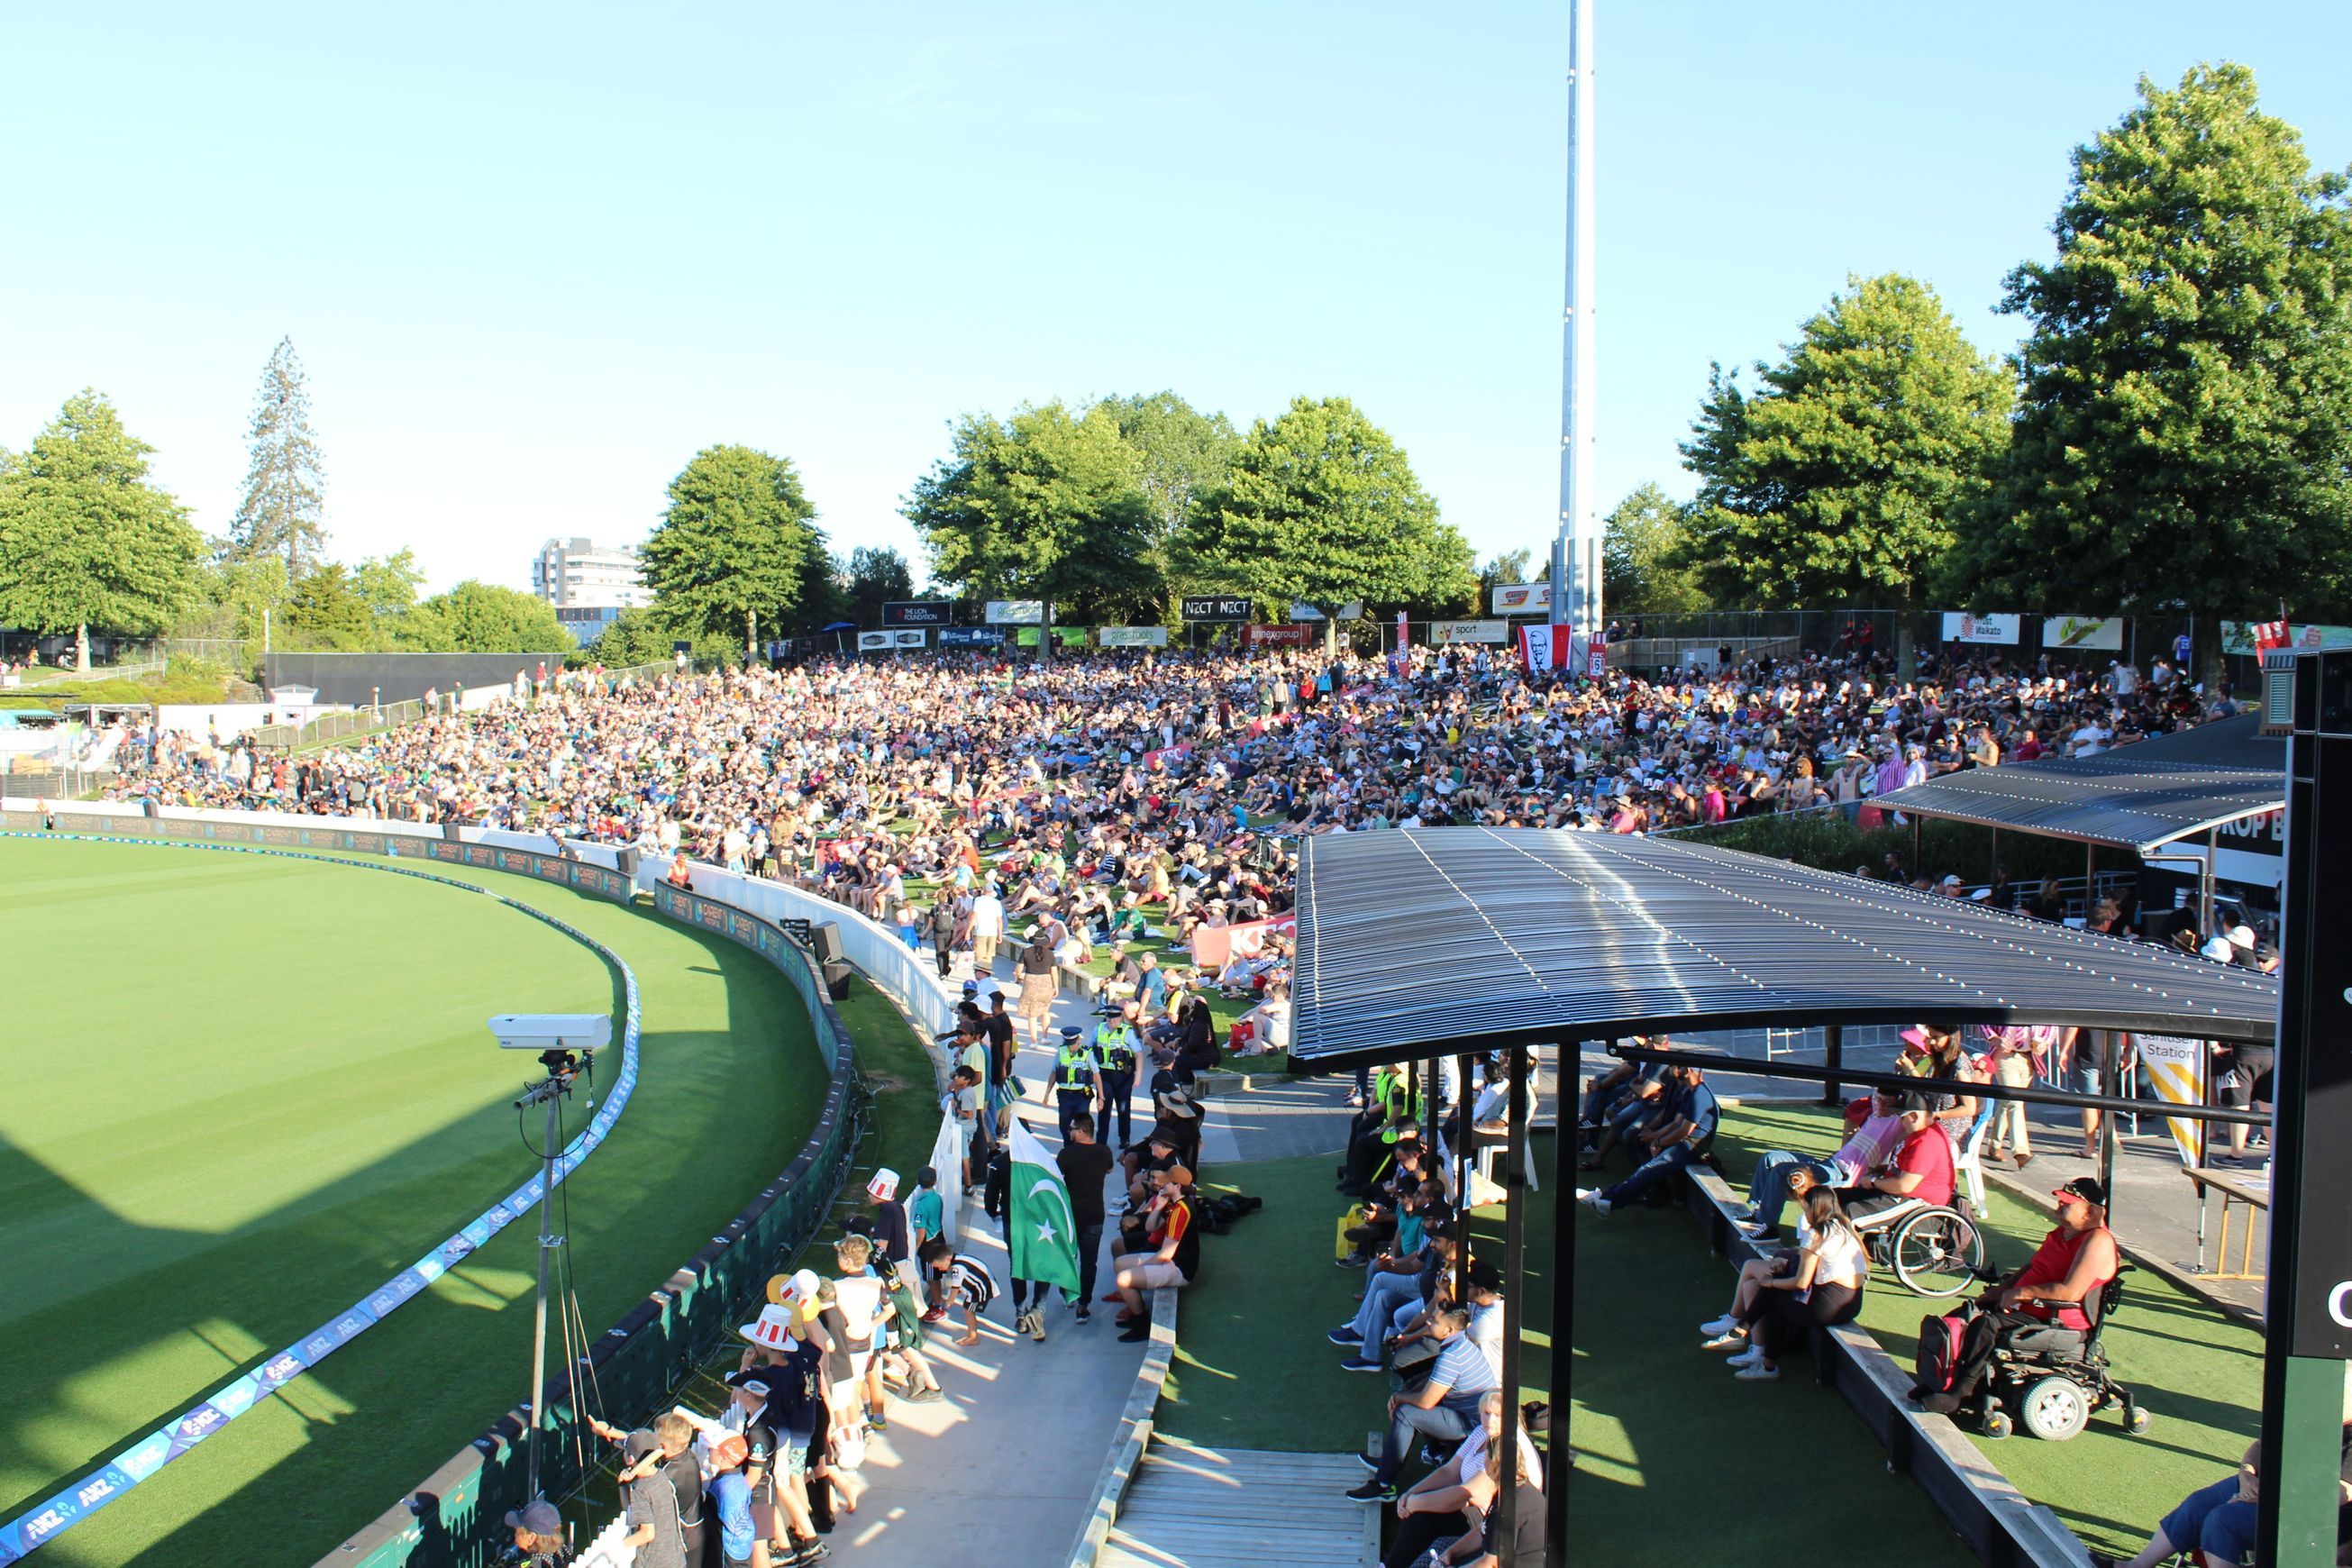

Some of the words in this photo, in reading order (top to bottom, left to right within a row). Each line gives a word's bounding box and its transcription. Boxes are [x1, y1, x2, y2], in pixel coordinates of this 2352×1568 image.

[1185, 602, 1213, 615] NZCT
[1219, 601, 1248, 614] NZCT
[1111, 630, 1153, 641] grassroots
[1251, 629, 1299, 644] annexgroup
[1975, 626, 2001, 635] Waikato
[1594, 660, 1600, 670] 6
[2215, 813, 2266, 838] ROP
[2147, 1044, 2195, 1059] Station
[336, 1317, 360, 1337] ANZ
[306, 1336, 333, 1357] ANZ
[278, 1355, 299, 1374] NZC
[193, 1408, 221, 1428] NZC
[77, 1478, 114, 1508] ANZ
[25, 1509, 66, 1540] ANZ
